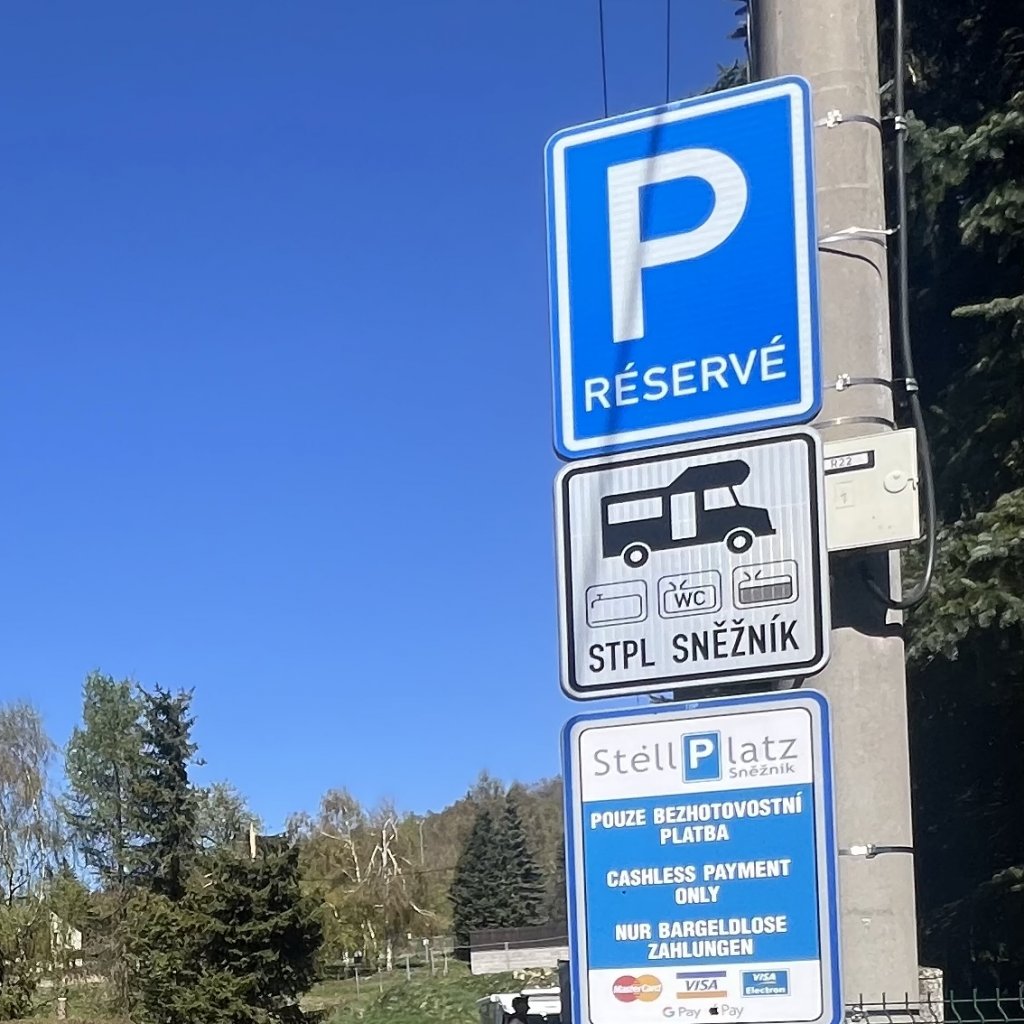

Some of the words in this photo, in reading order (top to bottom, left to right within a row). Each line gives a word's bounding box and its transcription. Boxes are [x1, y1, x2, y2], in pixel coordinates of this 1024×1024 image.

[607, 148, 748, 343] P
[585, 335, 786, 412] RÉSERVÉ
[674, 590, 706, 608] WC
[589, 638, 655, 673] STPL
[672, 614, 799, 663] SNĚŽNÍK
[590, 809, 646, 829] POUZE
[653, 791, 803, 823] BEZHOTOVOSTNÍ
[660, 824, 729, 845] PLATBA
[606, 866, 696, 888] CASHLESS
[703, 859, 791, 881] PAYMENT
[675, 886, 720, 905] ONLY
[615, 923, 652, 941] NUR
[658, 916, 787, 939] BARGELDLOSE
[647, 938, 753, 960] ZAHLUNGEN
[685, 979, 718, 991] VISA
[752, 973, 776, 982] VISA
[745, 986, 786, 995] Electron
[678, 1006, 701, 1019] Pay
[721, 1004, 744, 1019] Pay
